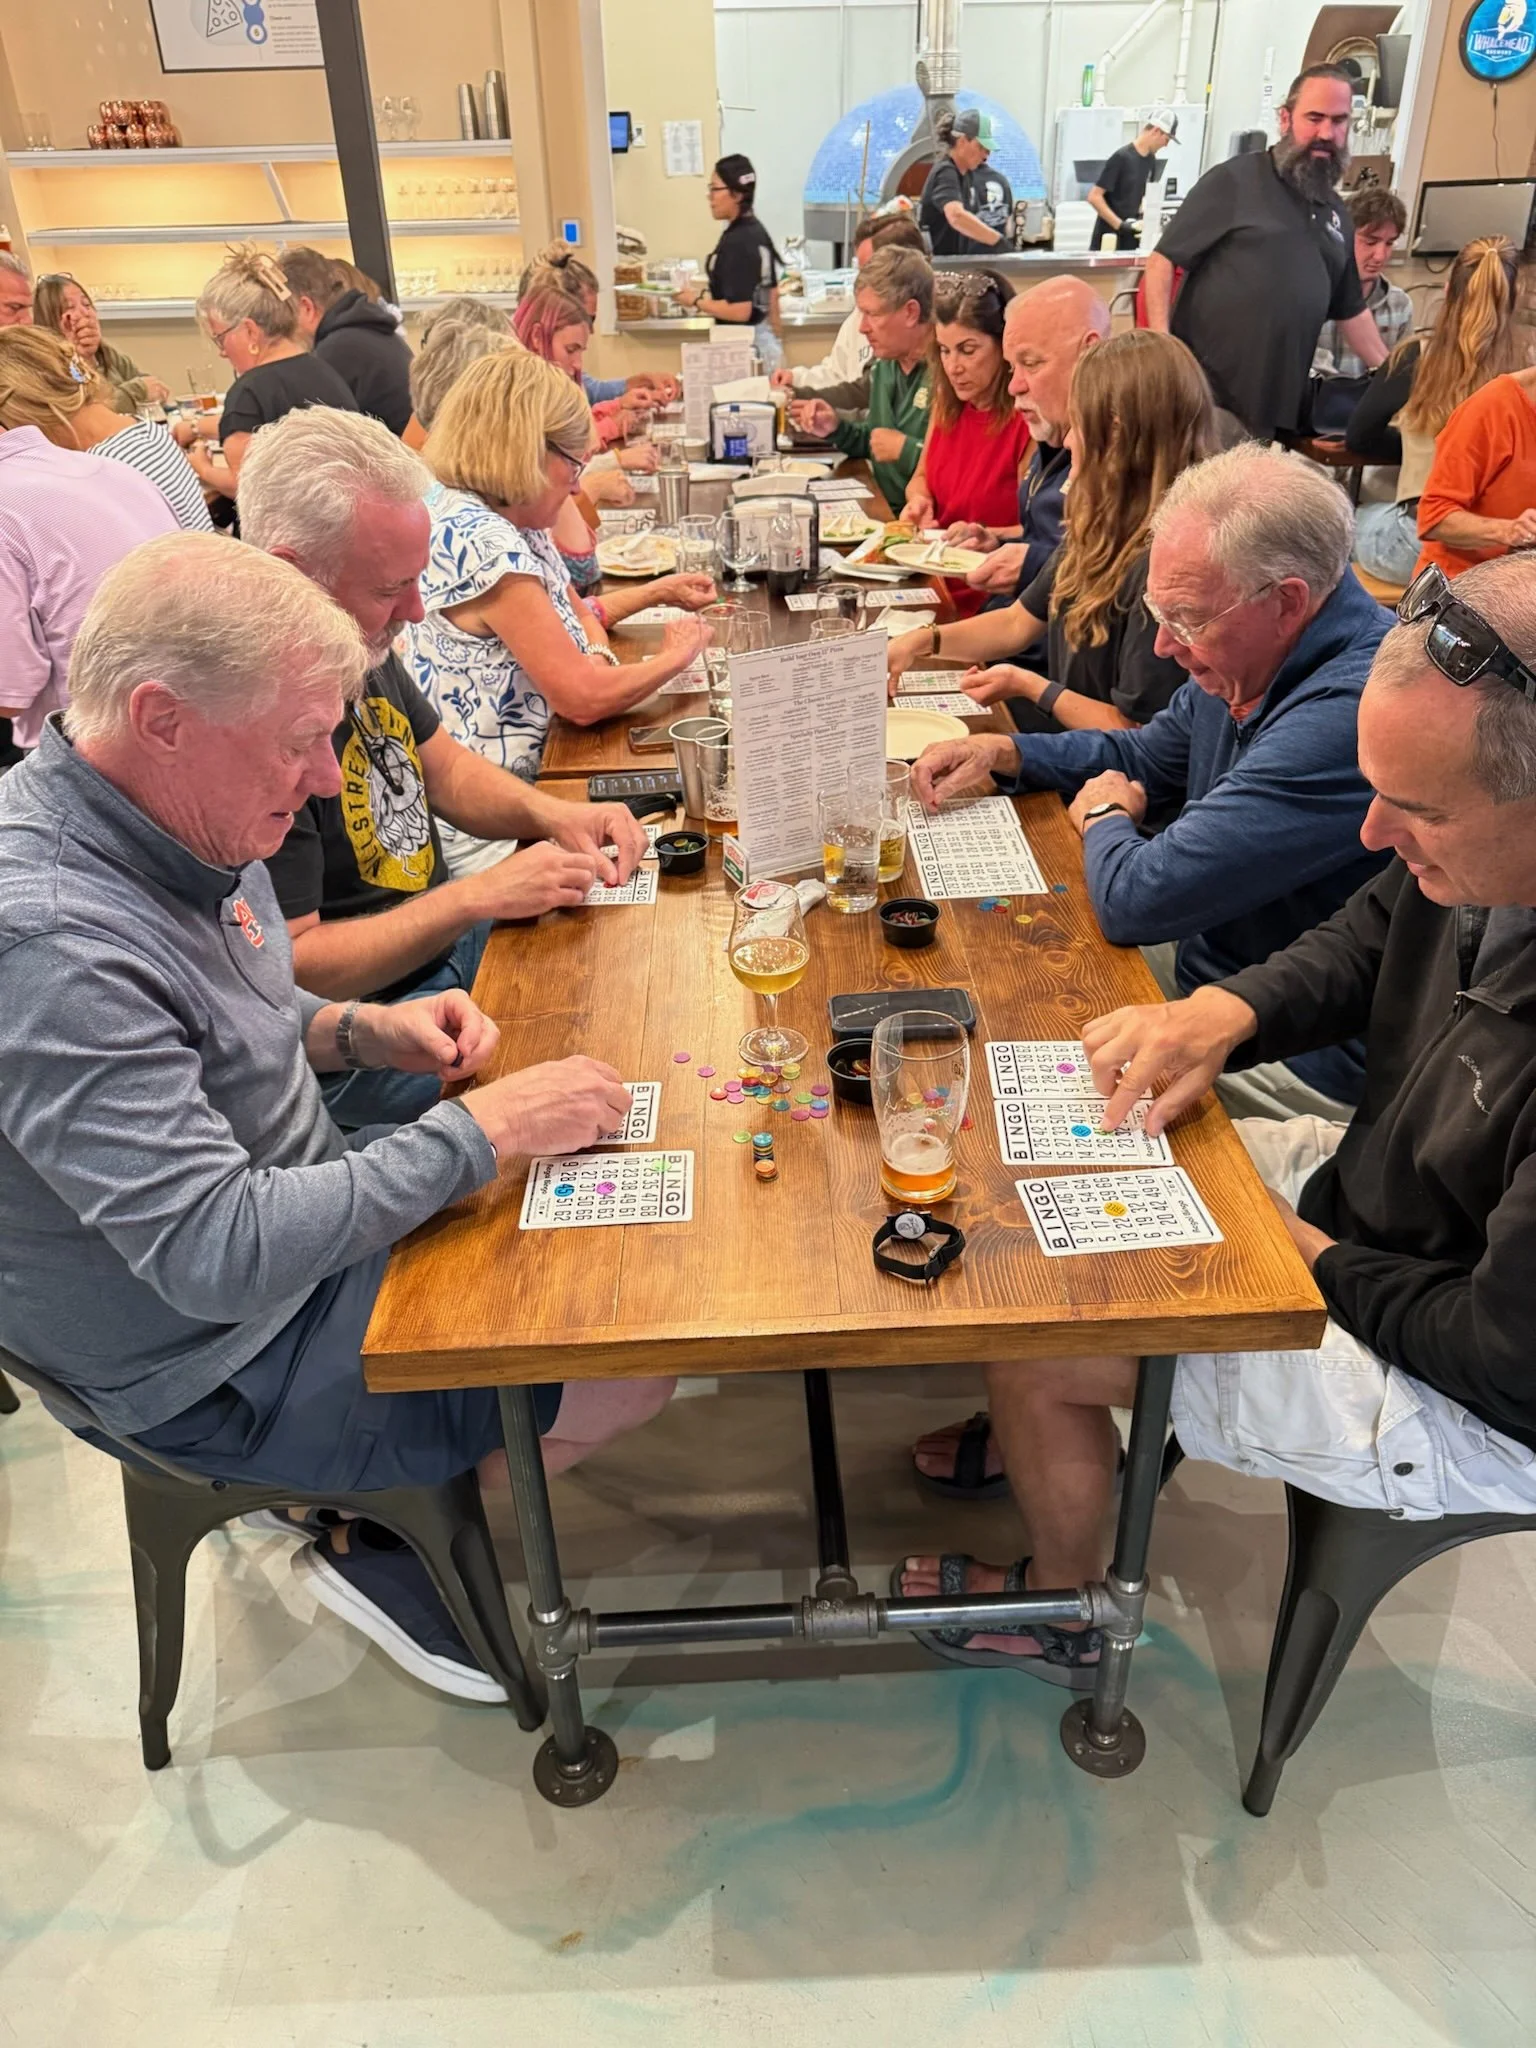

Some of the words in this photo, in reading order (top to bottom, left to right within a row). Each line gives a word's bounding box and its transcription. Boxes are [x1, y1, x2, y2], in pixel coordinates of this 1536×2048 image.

[910, 802, 925, 829] BINGO
[918, 832, 934, 861] BINGO
[926, 864, 944, 896] BINGO
[636, 871, 650, 901] BINGO
[996, 1045, 1017, 1094] BINGO
[1022, 1075, 1038, 1084] 26
[1042, 1075, 1057, 1084] 28
[631, 1086, 649, 1138] BINGO
[1028, 1104, 1042, 1112] 75
[1048, 1103, 1063, 1112] 70
[1068, 1104, 1084, 1113] 63
[1088, 1104, 1105, 1113] 69
[1030, 1115, 1045, 1123] 57
[1050, 1115, 1066, 1124] 50
[1070, 1115, 1087, 1124] 47
[1007, 1103, 1028, 1160] BINGO
[1032, 1126, 1047, 1135] 42
[1053, 1126, 1068, 1135] 33
[1115, 1127, 1131, 1136] 32
[1034, 1138, 1049, 1147] 25
[1055, 1138, 1071, 1147] 27
[1076, 1138, 1092, 1148] 22
[1096, 1138, 1114, 1148] 26
[1118, 1138, 1135, 1148] 23
[1035, 1150, 1052, 1159] 12
[1057, 1150, 1073, 1158] 15
[1077, 1151, 1094, 1159] 14
[1100, 1151, 1116, 1159] 3
[624, 1157, 639, 1165] 10
[560, 1172, 577, 1182] 28
[581, 1170, 597, 1180] 27
[602, 1169, 618, 1178] 26
[623, 1168, 638, 1178] 23
[644, 1168, 659, 1177] 25
[643, 1180, 659, 1189] 35
[1074, 1179, 1091, 1190] 64
[1093, 1177, 1112, 1188] 66
[1115, 1176, 1134, 1186] 74
[1136, 1175, 1155, 1184] 67
[557, 1183, 575, 1194] 45
[621, 1181, 637, 1190] 38
[665, 1155, 682, 1215] BINGO
[1051, 1181, 1068, 1191] 70
[1081, 1192, 1097, 1202] 54
[1100, 1191, 1119, 1201] 59
[1121, 1190, 1138, 1199] 47
[1143, 1187, 1162, 1197] 49
[557, 1198, 573, 1207] 51
[577, 1196, 594, 1206] 50
[599, 1194, 615, 1205] 46
[620, 1193, 636, 1203] 49
[642, 1193, 657, 1202] 47
[1057, 1193, 1074, 1204] 46
[1085, 1206, 1102, 1215] 41
[1128, 1202, 1148, 1213] 32
[1150, 1200, 1167, 1211] 42
[554, 1211, 571, 1221] 62
[576, 1209, 592, 1220] 66
[597, 1208, 614, 1219] 63
[619, 1208, 635, 1217] 61
[641, 1206, 657, 1216] 68
[1030, 1183, 1069, 1249] BINGO
[1063, 1207, 1080, 1217] 43
[1091, 1220, 1110, 1228] 17
[1113, 1218, 1132, 1229] 22
[1136, 1217, 1154, 1227] 19
[1157, 1214, 1177, 1225] 20
[1071, 1221, 1088, 1230] 21
[1076, 1236, 1093, 1244] 9
[1121, 1232, 1138, 1242] 13
[1144, 1232, 1161, 1240] 6
